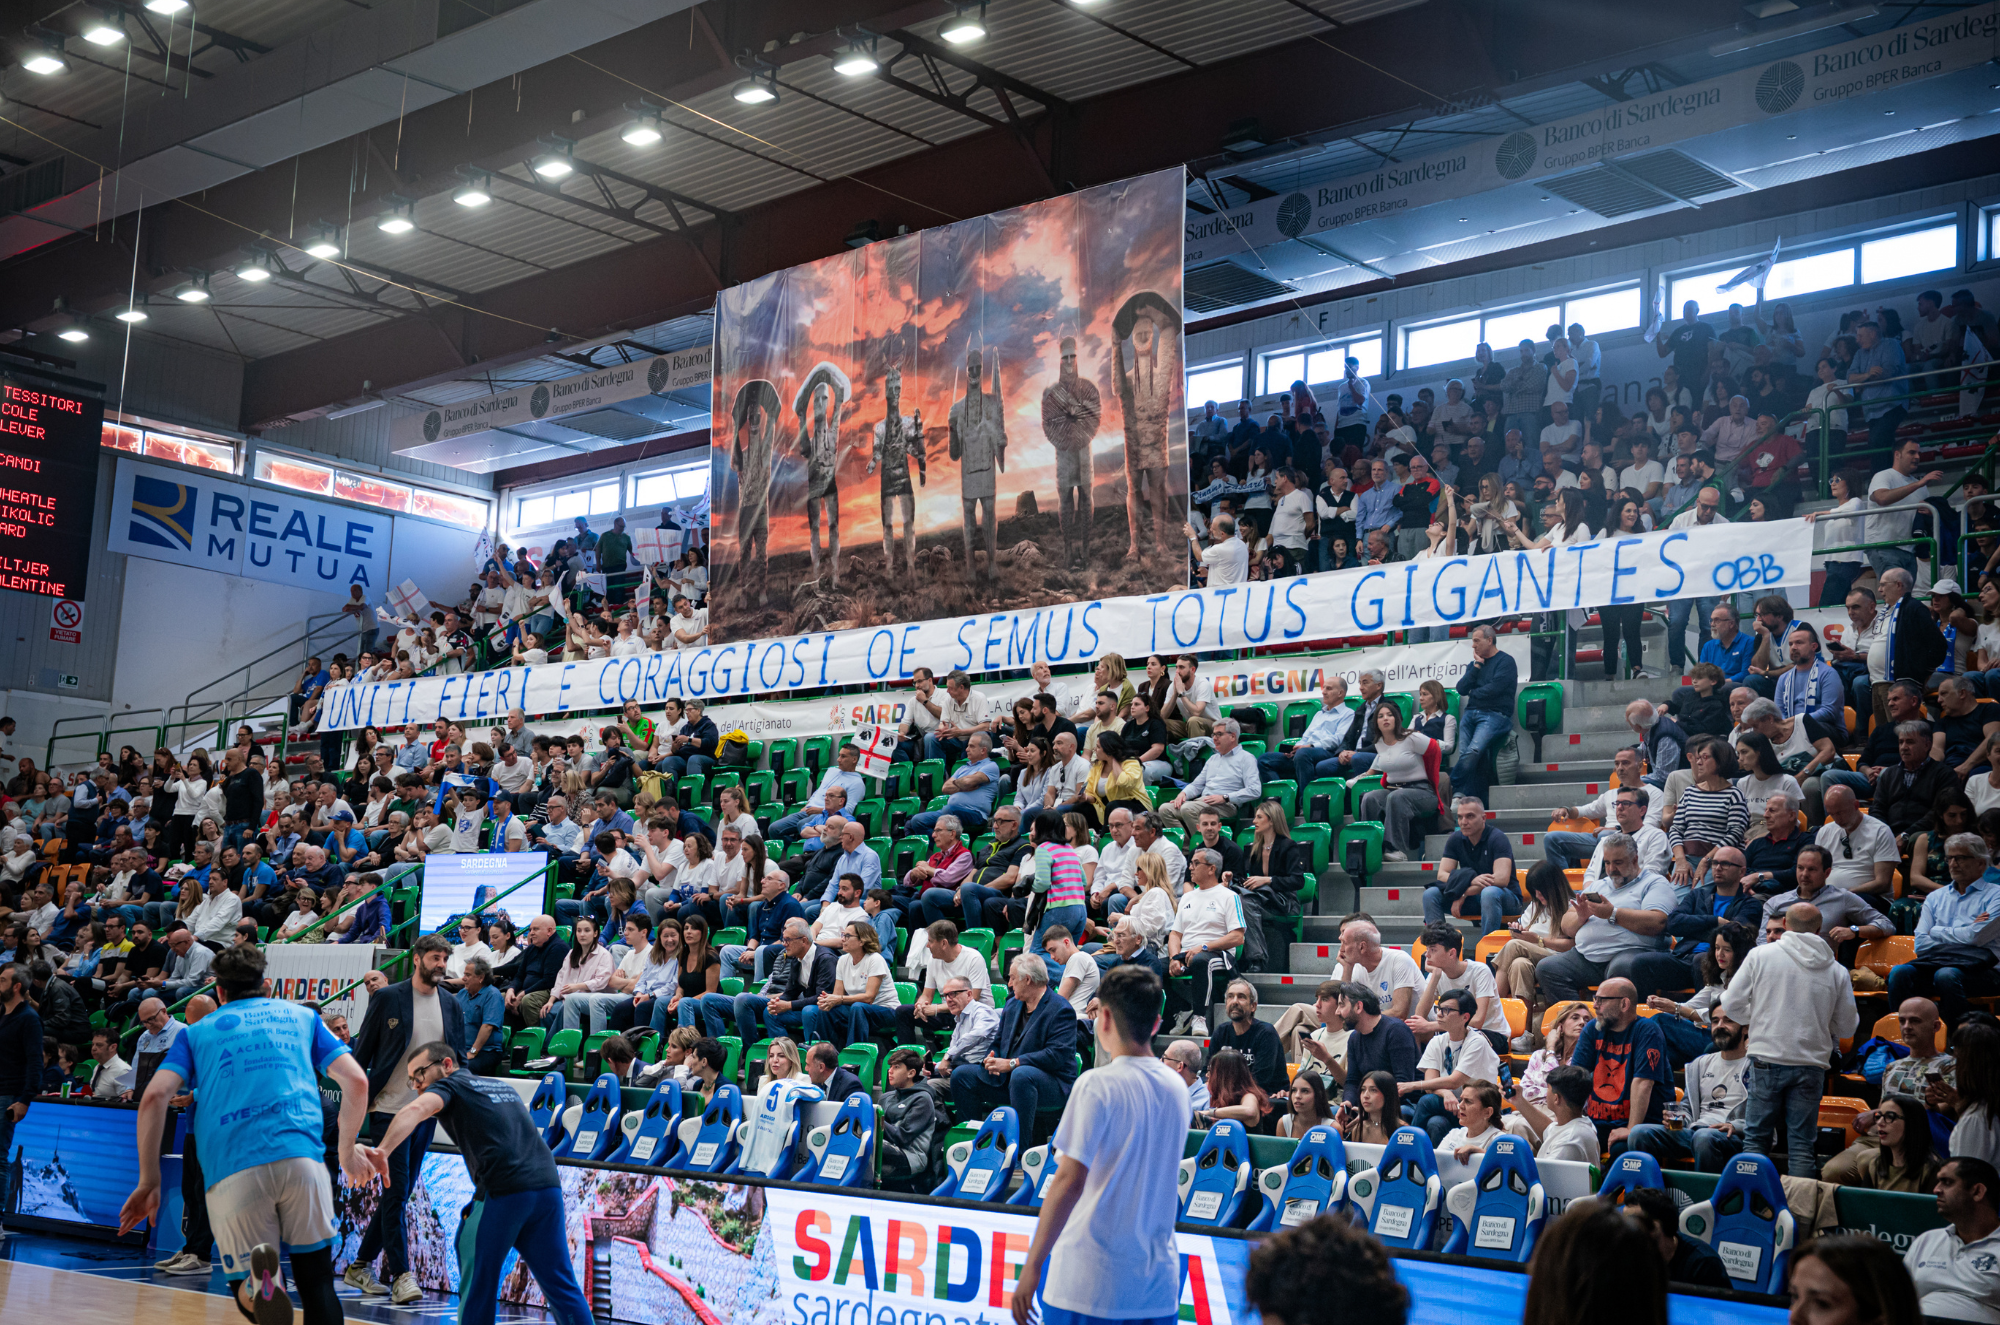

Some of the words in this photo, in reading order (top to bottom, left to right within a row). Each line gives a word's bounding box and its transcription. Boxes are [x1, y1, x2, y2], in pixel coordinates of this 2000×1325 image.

[1813, 44, 1883, 77] Banco
[1888, 34, 1908, 58] di
[1814, 81, 1863, 101] Gruppo
[1866, 66, 1899, 88] BPER
[1902, 60, 1942, 78] Banca
[1544, 118, 1600, 147] Banco
[1605, 110, 1623, 132] di
[1627, 87, 1721, 126] Sardegna
[1544, 150, 1586, 169] Gruppo
[1587, 141, 1615, 159] BPER
[1617, 134, 1650, 152] Banca
[1317, 182, 1367, 207] Banco
[1370, 173, 1385, 194] di
[1388, 156, 1467, 190] Sardegna
[1318, 211, 1354, 229] Gruppo
[1355, 203, 1378, 219] BPER
[1380, 198, 1408, 213] Banca
[1185, 212, 1254, 243] Sardegna
[1319, 311, 1329, 330] F
[673, 352, 702, 370] Banco
[553, 381, 580, 399] Banco
[581, 376, 591, 393] di
[590, 369, 634, 391] Sardegna
[672, 374, 694, 387] Gruppo
[694, 370, 709, 383] BPER
[4, 385, 83, 414] TESSITORI
[444, 405, 469, 422] Banco
[470, 401, 478, 417] di
[479, 395, 518, 416] Sardegna
[553, 403, 573, 414] Gruppo
[573, 399, 586, 410] BPER
[587, 396, 602, 407] Banca
[2, 402, 39, 422] COLE
[0, 419, 46, 440] LEVER
[444, 427, 462, 438] Gruppo
[462, 424, 474, 434] BPER
[474, 421, 489, 431] Banca
[0, 487, 57, 510] HEATLE
[210, 491, 374, 559] REALE
[0, 556, 50, 577] LTJER
[207, 533, 371, 588] MUTUA
[1712, 553, 1785, 591] OBB
[0, 574, 66, 597] LENTINE
[55, 629, 77, 637] VIETATO
[438, 667, 531, 719] FIERI
[558, 665, 576, 710] E
[867, 625, 921, 679] OE
[954, 600, 1102, 672] SEMUS
[1146, 577, 1308, 653] TOTUS
[1350, 532, 1689, 632] GIGANTES
[54, 634, 76, 642] FUMARE
[1206, 668, 1325, 698] RDEGNA
[720, 716, 792, 734] dell'Artigianato
[461, 857, 508, 869] SARDEGNA
[244, 1009, 281, 1019] Banco
[245, 1014, 298, 1027] Sardegna
[216, 1032, 249, 1046] Gruppo
[252, 1028, 273, 1037] BPER
[275, 1028, 298, 1038] Banca
[236, 1041, 297, 1055] ACRISURE
[244, 1055, 290, 1066] fondazione
[766, 1082, 784, 1112] 5
[1381, 1217, 1407, 1227] Sardegna
[1482, 1220, 1500, 1228] Banco
[1480, 1228, 1508, 1238] Sardegna
[1721, 1255, 1754, 1268] Sardegna
[1722, 1246, 1744, 1257] Banco
[1745, 1249, 1752, 1258] di
